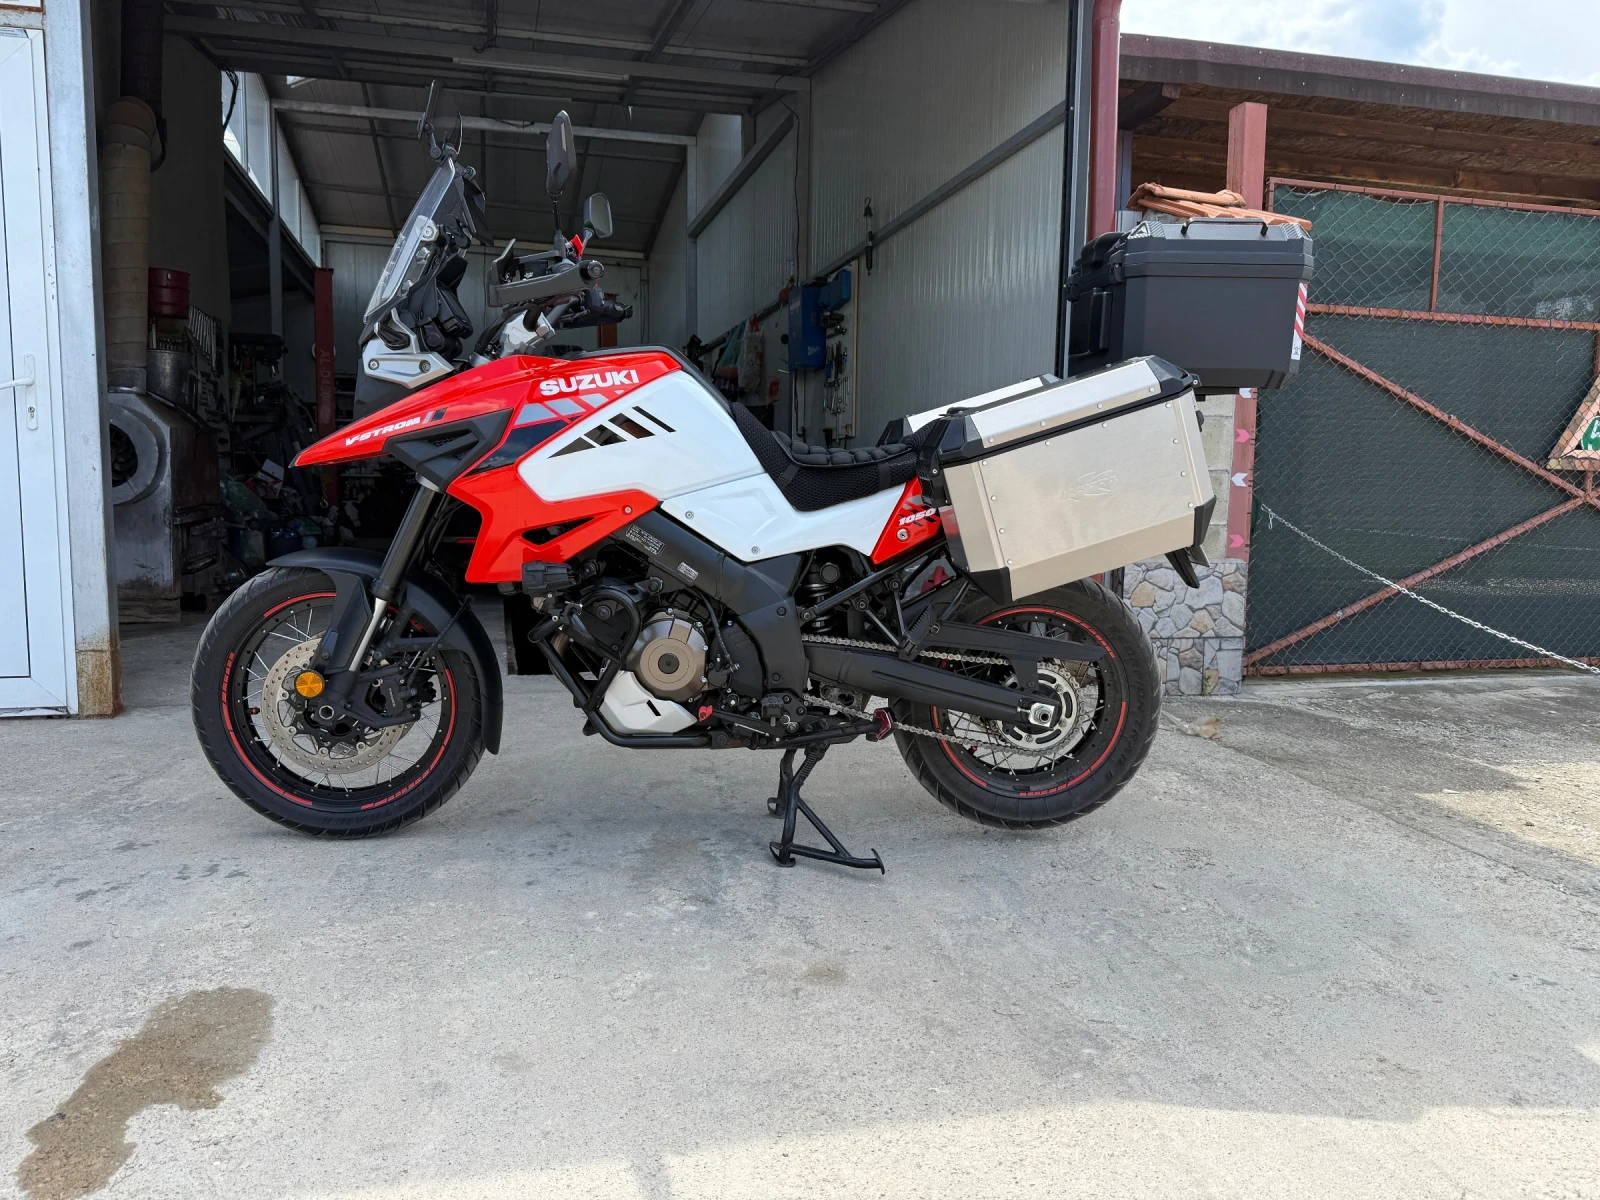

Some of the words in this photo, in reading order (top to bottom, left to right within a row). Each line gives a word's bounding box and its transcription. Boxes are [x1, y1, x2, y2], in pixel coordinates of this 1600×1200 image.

[540, 369, 639, 396] SUZUKI
[345, 417, 421, 447] V-STROM
[899, 507, 936, 526] 1050
